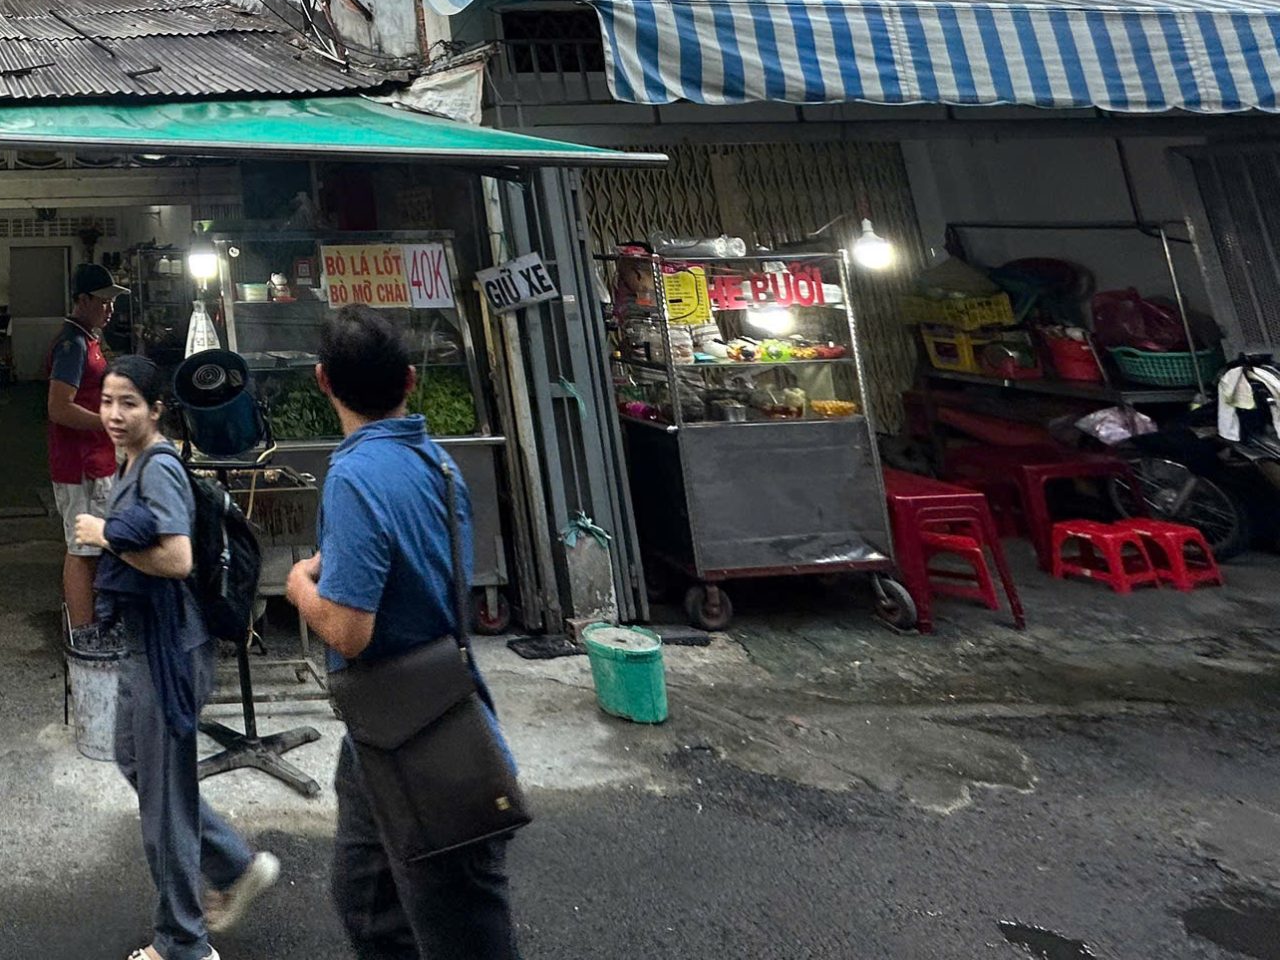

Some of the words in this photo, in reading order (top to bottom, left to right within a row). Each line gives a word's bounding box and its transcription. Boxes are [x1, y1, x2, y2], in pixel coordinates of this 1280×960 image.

[324, 251, 346, 276] BÒ
[350, 250, 371, 276] LÁ
[373, 248, 401, 276] LỐT
[411, 250, 450, 299] 40K
[329, 280, 348, 303] BÒ
[351, 280, 373, 303] MỠ
[376, 279, 409, 302] CHÀI
[485, 268, 521, 309] GIỮ
[518, 263, 554, 297] XE
